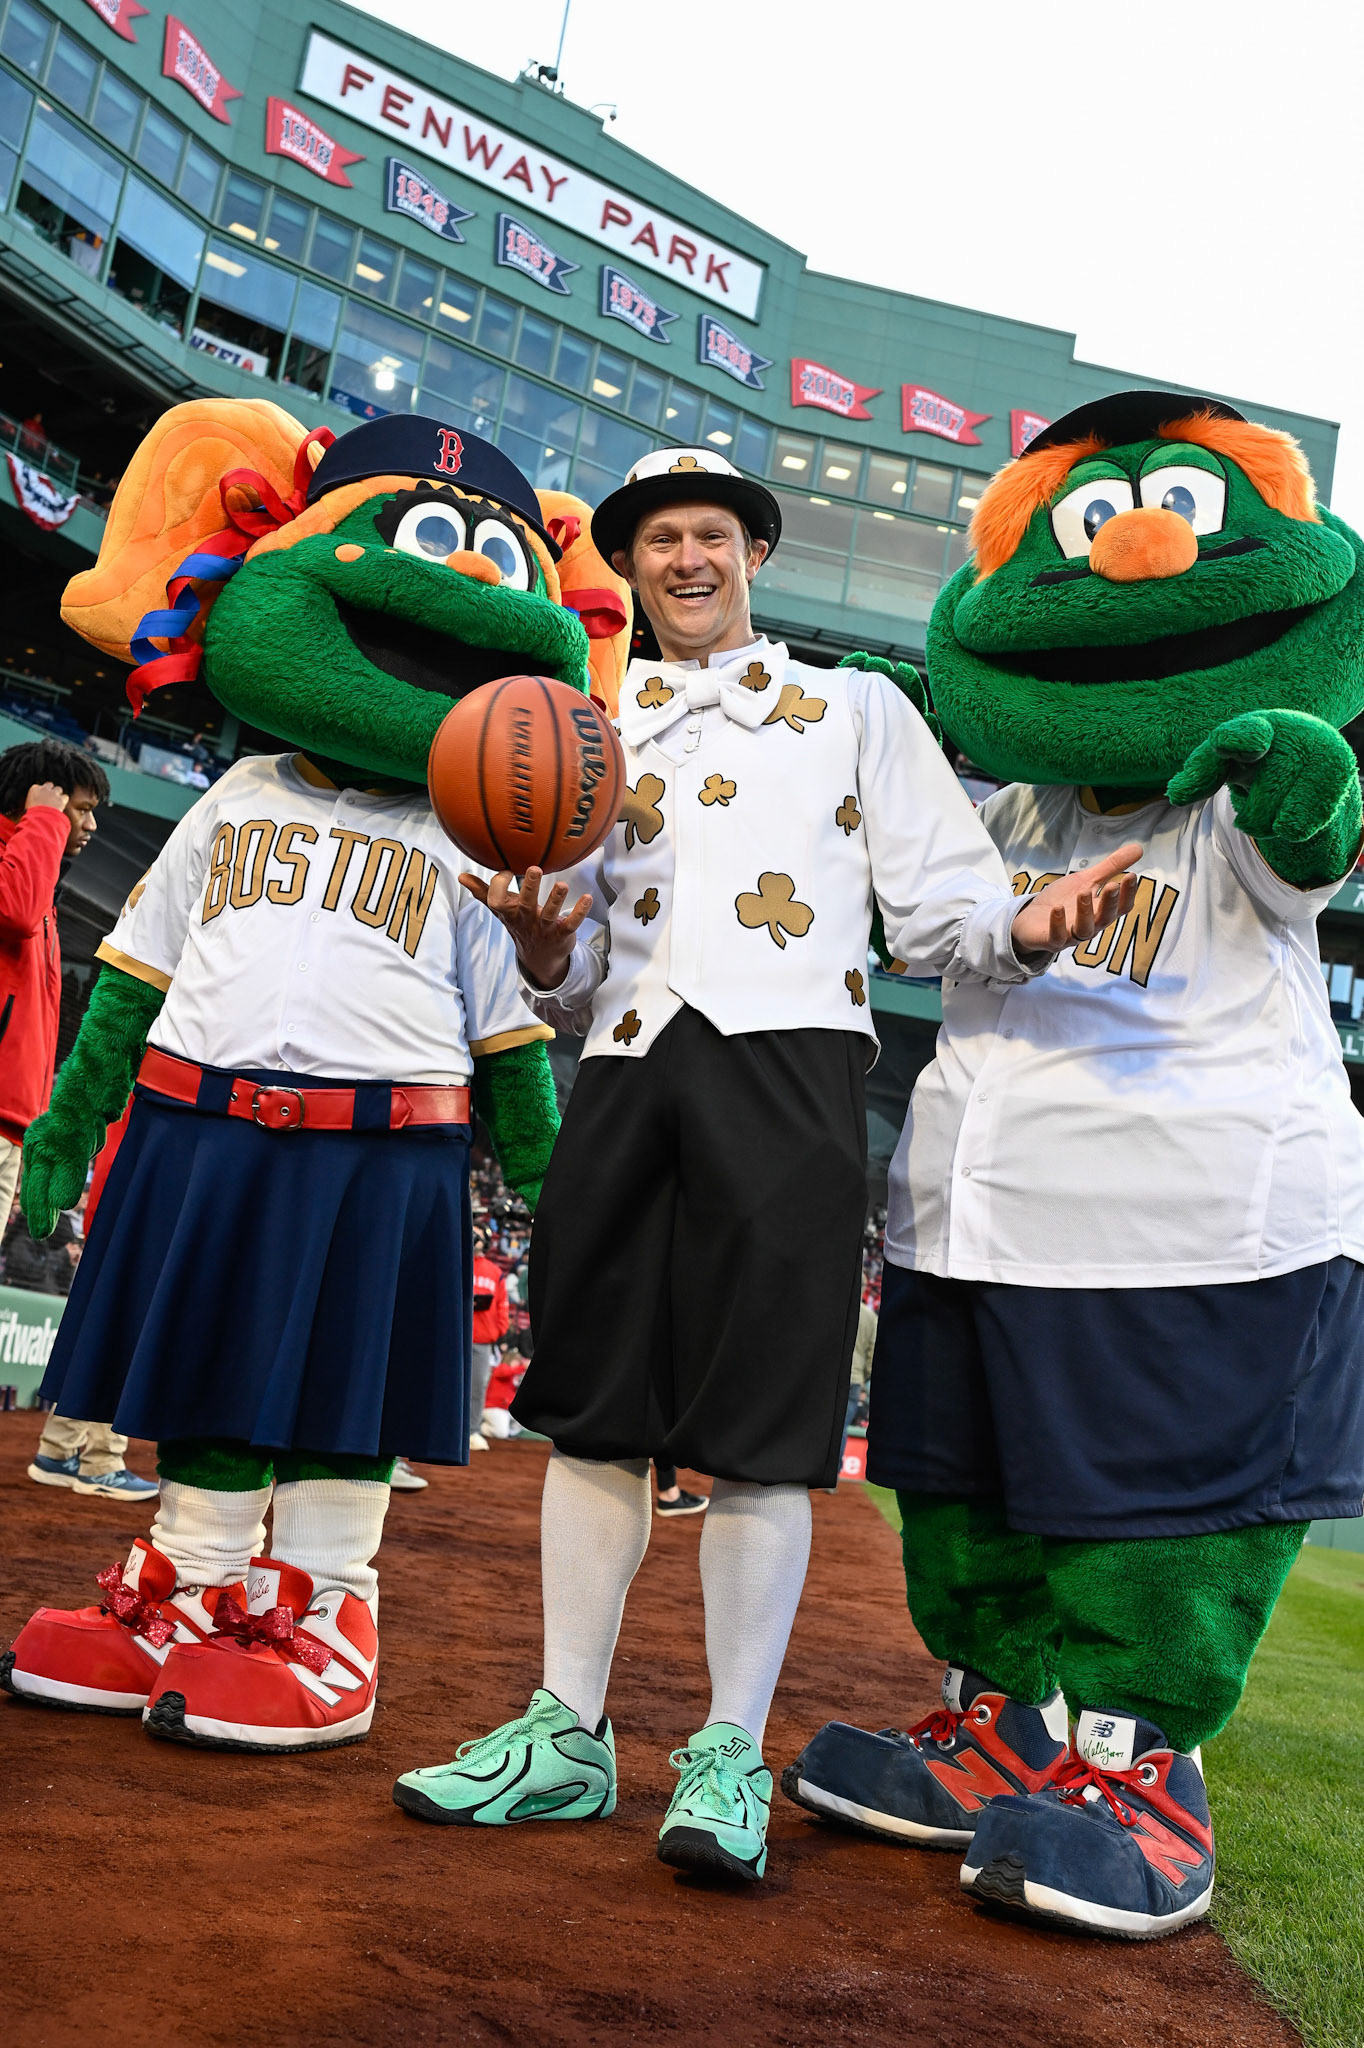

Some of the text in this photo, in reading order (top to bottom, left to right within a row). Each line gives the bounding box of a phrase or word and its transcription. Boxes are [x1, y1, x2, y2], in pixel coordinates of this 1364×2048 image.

[176, 39, 217, 98] 1916
[280, 117, 334, 167] 1918
[341, 63, 731, 293] FENWAY PARK
[396, 175, 450, 225] 1946
[506, 229, 557, 275] 1967
[610, 281, 657, 327] 1975
[800, 370, 857, 407] 2004
[910, 397, 966, 433] 2007
[433, 428, 465, 475] B
[565, 706, 607, 842] Wilson
[202, 819, 440, 959] BOSTON
[1082, 1739, 1109, 1765] Wally
[1130, 1811, 1206, 1890] N
